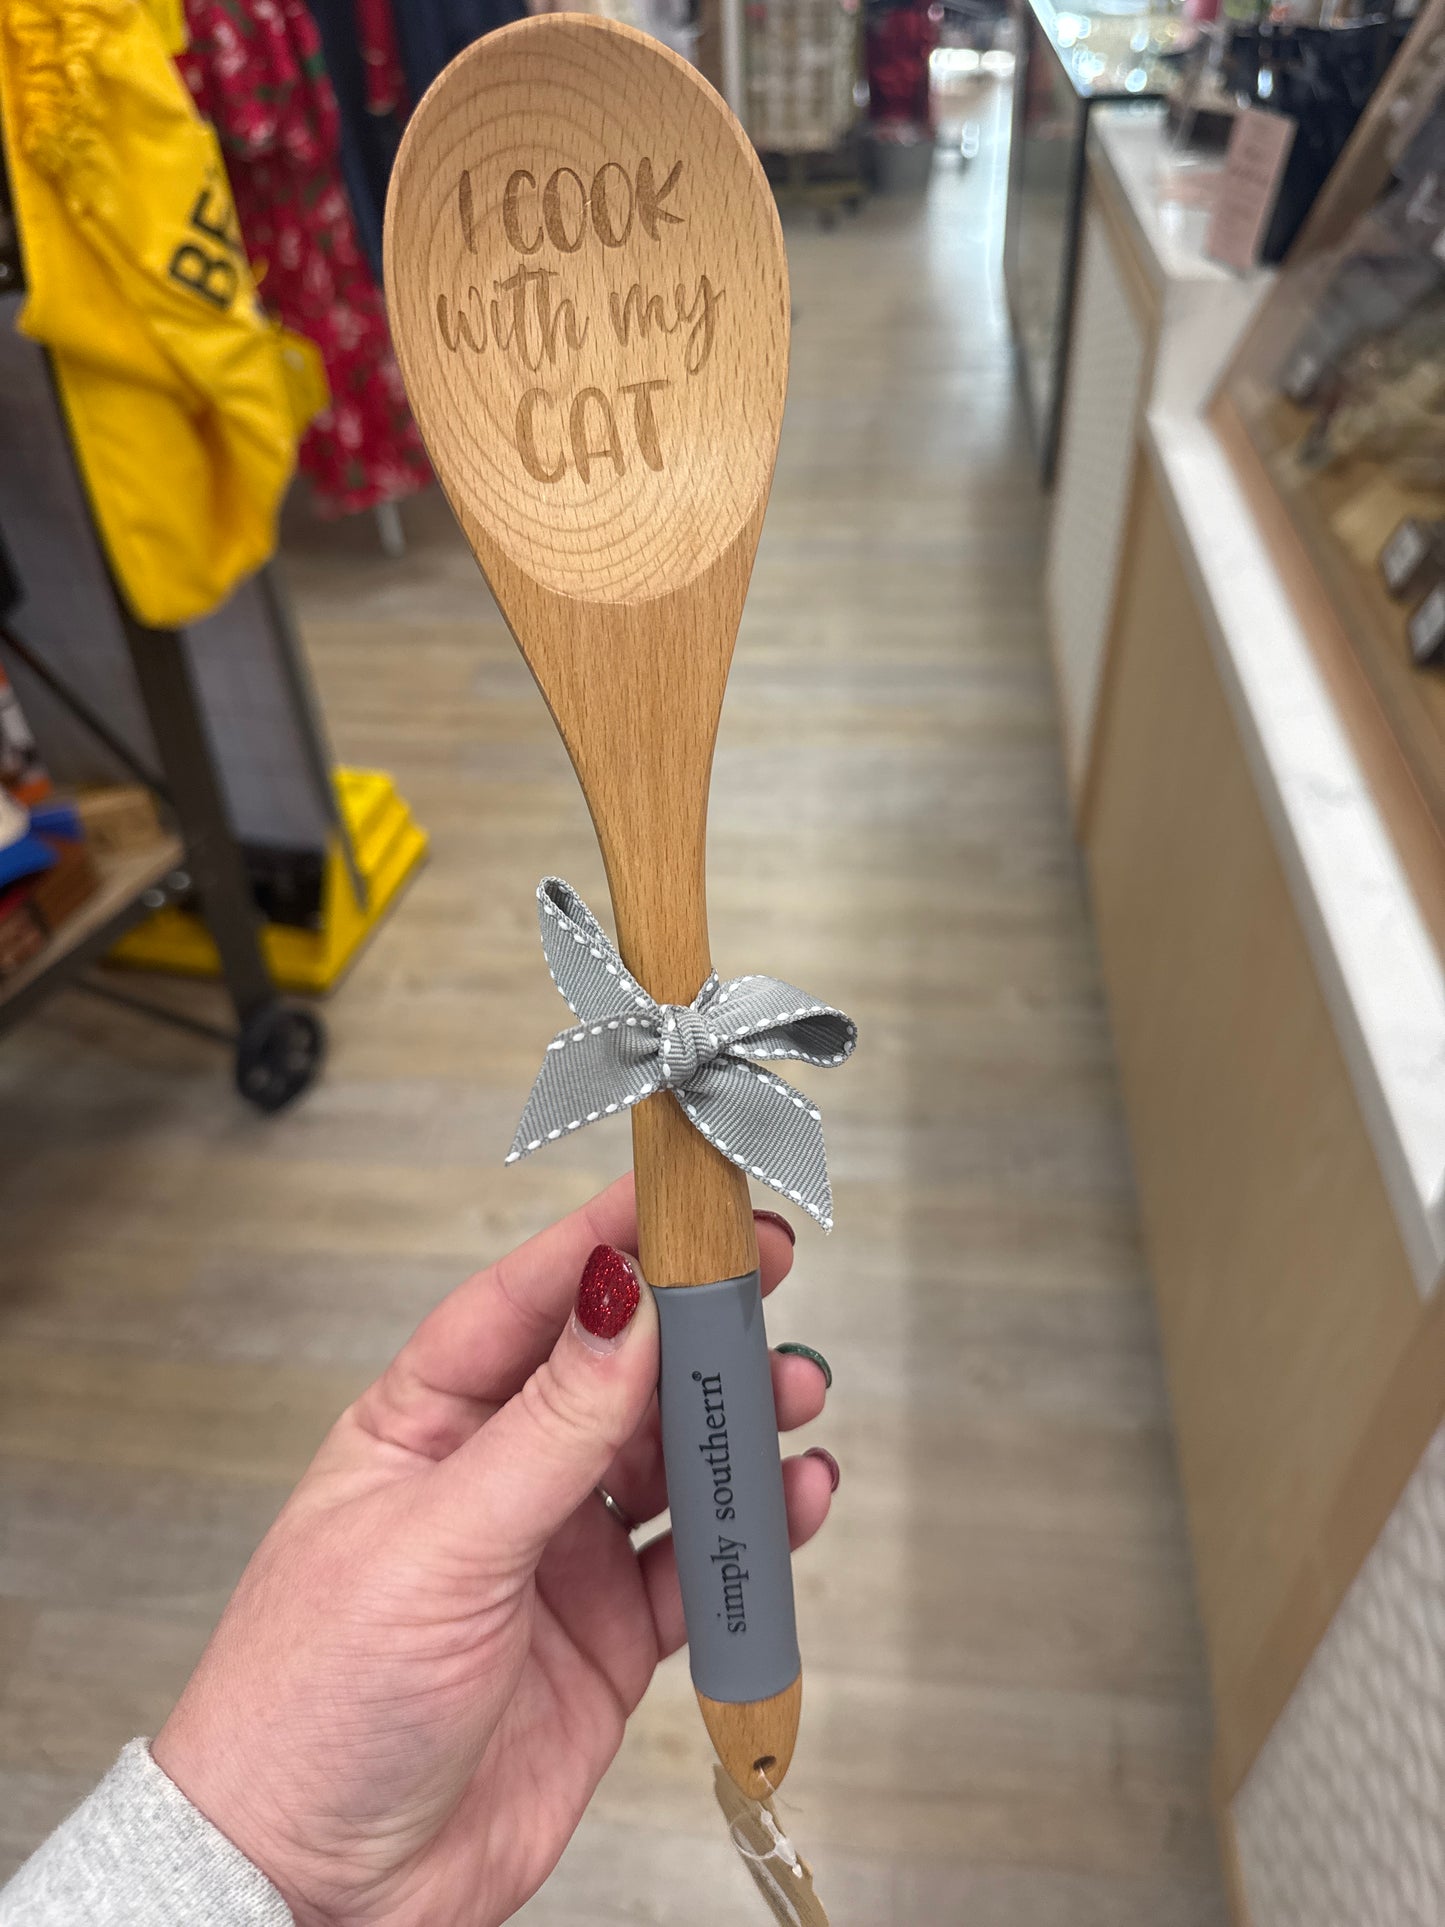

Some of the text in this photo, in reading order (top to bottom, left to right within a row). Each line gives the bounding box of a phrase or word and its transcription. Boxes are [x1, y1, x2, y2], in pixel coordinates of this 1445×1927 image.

[459, 156, 686, 255] I COOK
[436, 263, 726, 376] with my
[515, 379, 671, 484] CAT
[710, 1535, 749, 1634] simply
